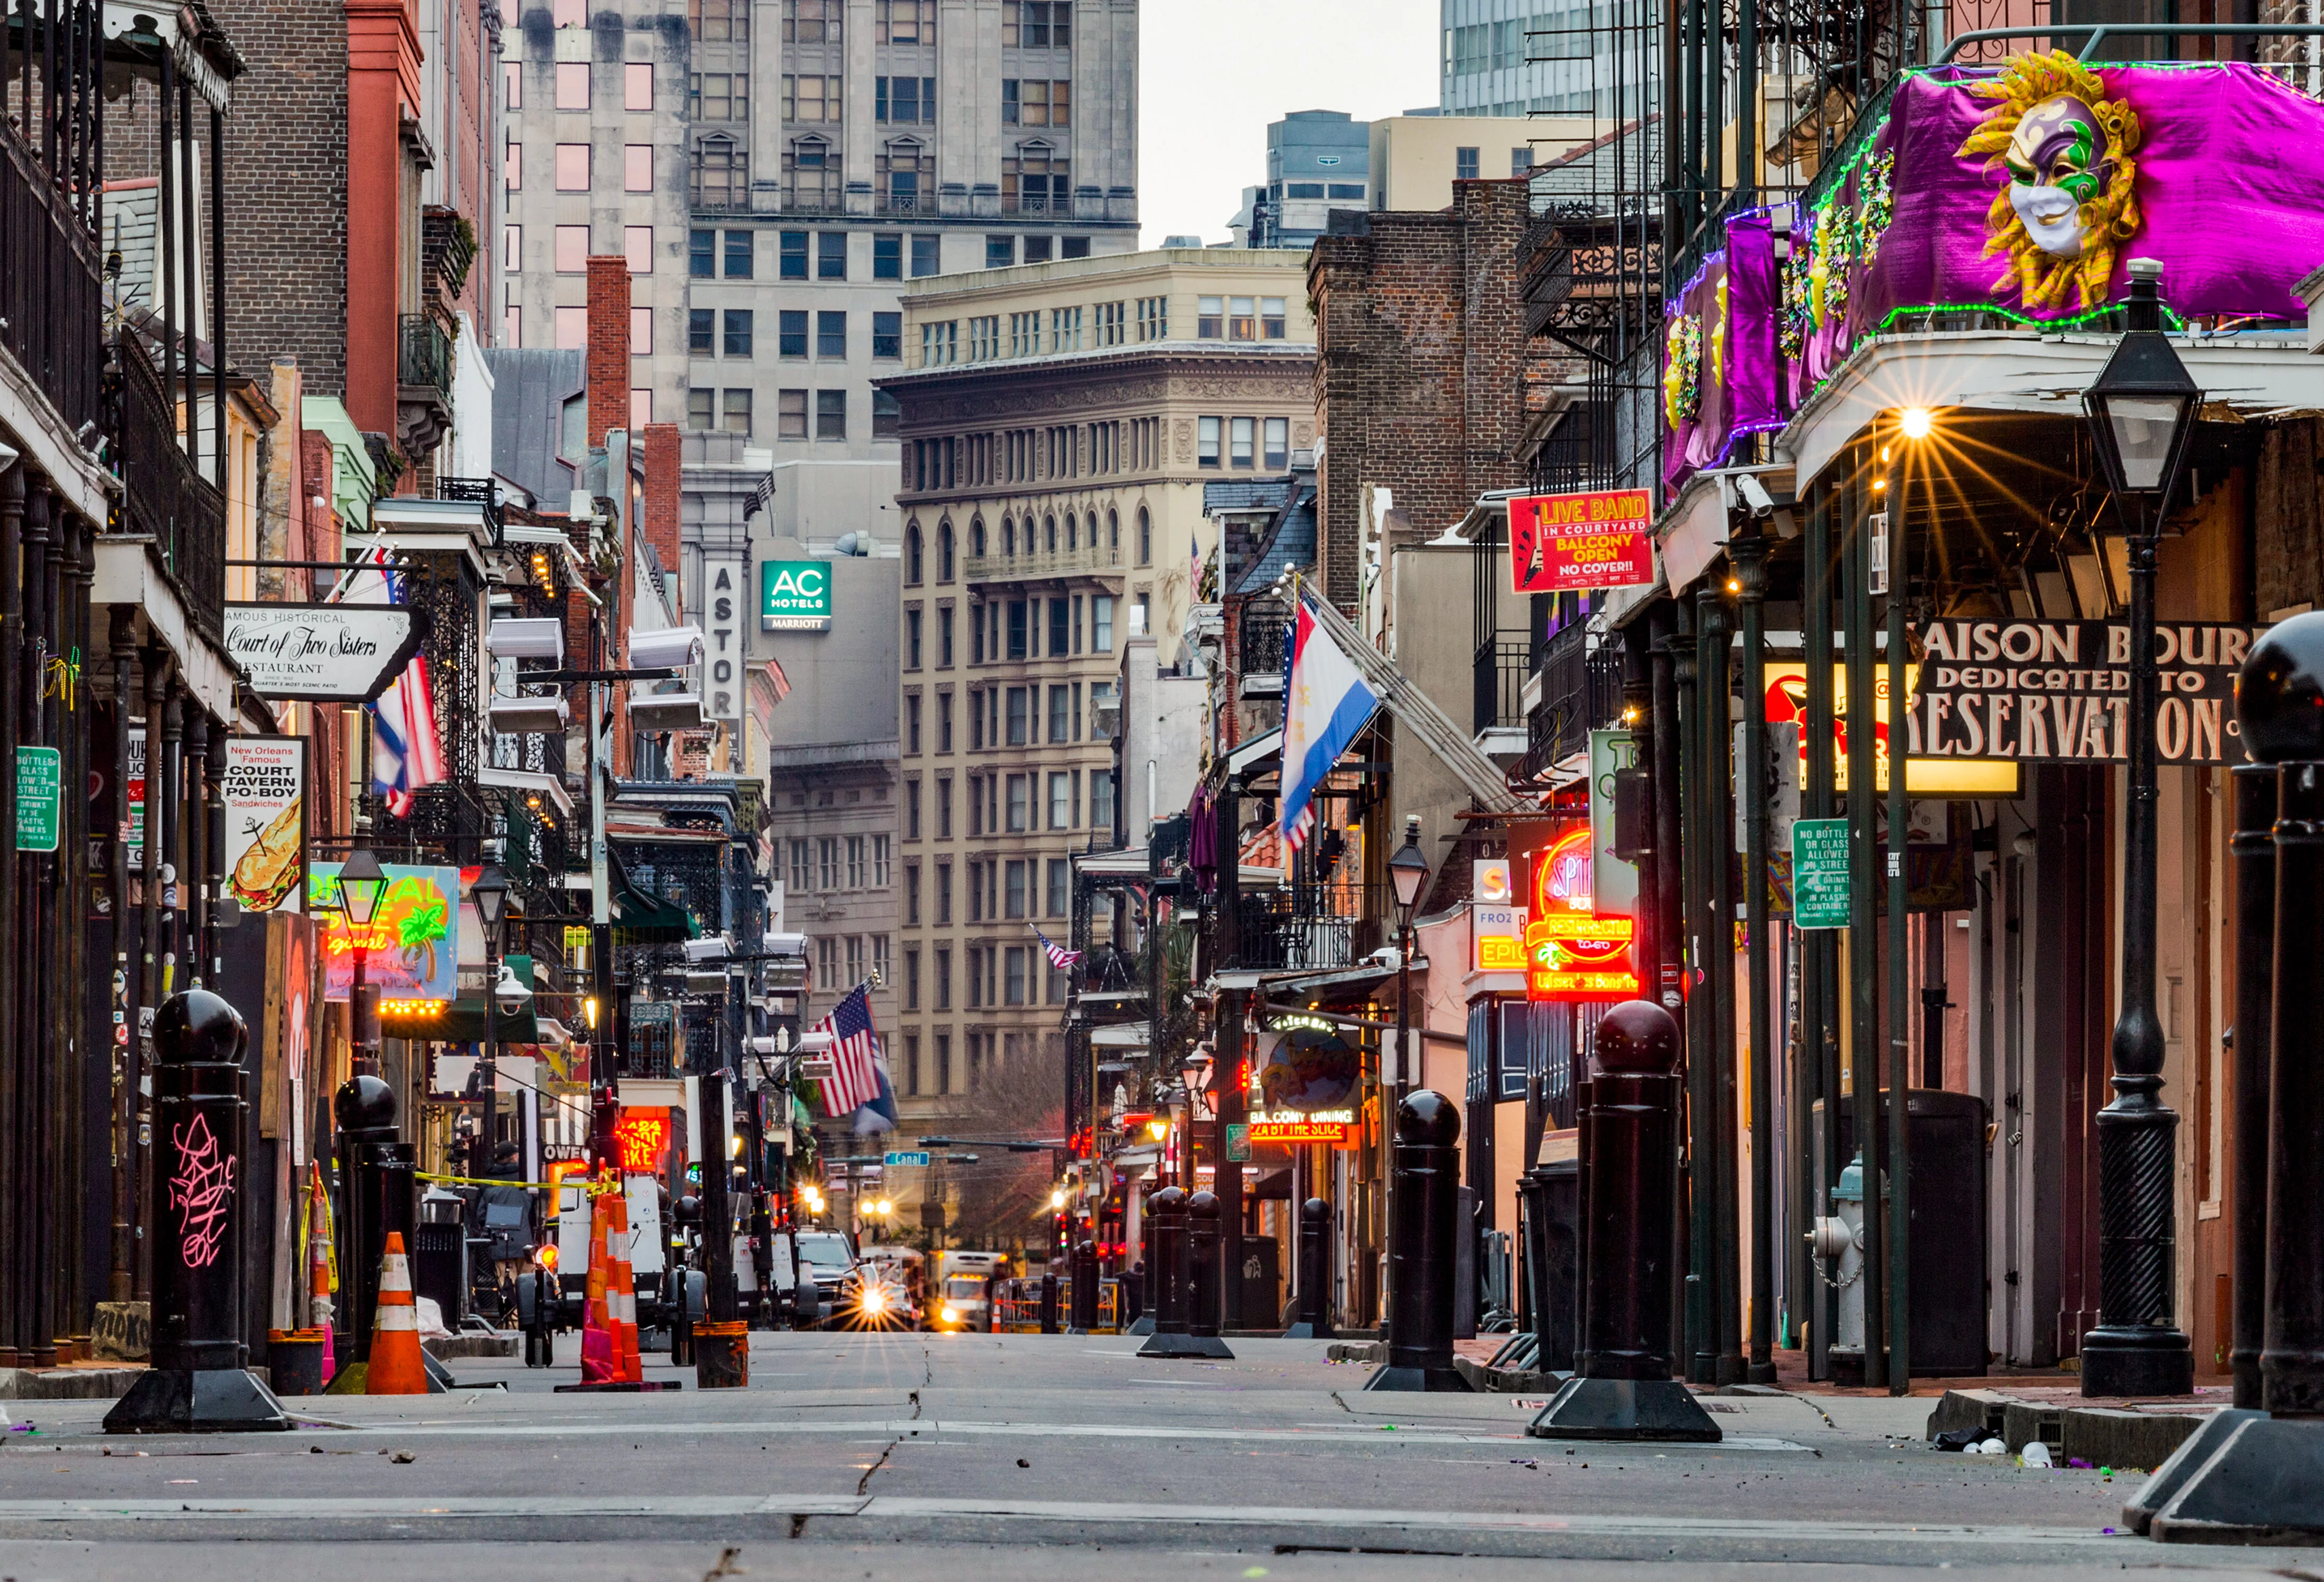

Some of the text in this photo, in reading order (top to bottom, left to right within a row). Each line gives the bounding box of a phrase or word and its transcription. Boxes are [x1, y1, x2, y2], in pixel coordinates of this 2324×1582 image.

[1541, 496, 1646, 524] LIVE BAND
[1544, 521, 1646, 536] IN COURTYARD
[1556, 533, 1633, 551] BALCONY
[1573, 548, 1618, 562] OPEN
[1559, 561, 1633, 576] NO COVER!!
[771, 569, 823, 597] AC
[771, 599, 823, 608] HOTELS
[224, 613, 345, 624] AMOUS HISTORICAL
[772, 619, 823, 628] MARRIOTT
[226, 624, 377, 661] Court of Two Sisters
[714, 568, 732, 714] ASTOR
[1905, 622, 2081, 663] AISON
[239, 662, 324, 674] ESTAURANT
[1936, 666, 2130, 690] DEDICATED
[2160, 671, 2205, 692] TO
[255, 747, 293, 755] Orleans
[242, 755, 281, 764] Famous
[21, 767, 48, 775] GLASS
[229, 766, 293, 776] COURT
[17, 776, 46, 785] LOWED
[227, 777, 296, 787] TAVERN
[18, 786, 50, 795] STREET
[226, 787, 296, 797] PO-BOY
[1805, 840, 1849, 849] OR GLASS
[1808, 850, 1849, 859] ALLOWED
[1804, 861, 1816, 870] ON
[1807, 902, 1849, 911] CONTAINER
[1596, 973, 1623, 990] Bons
[896, 1152, 920, 1165] Canal
